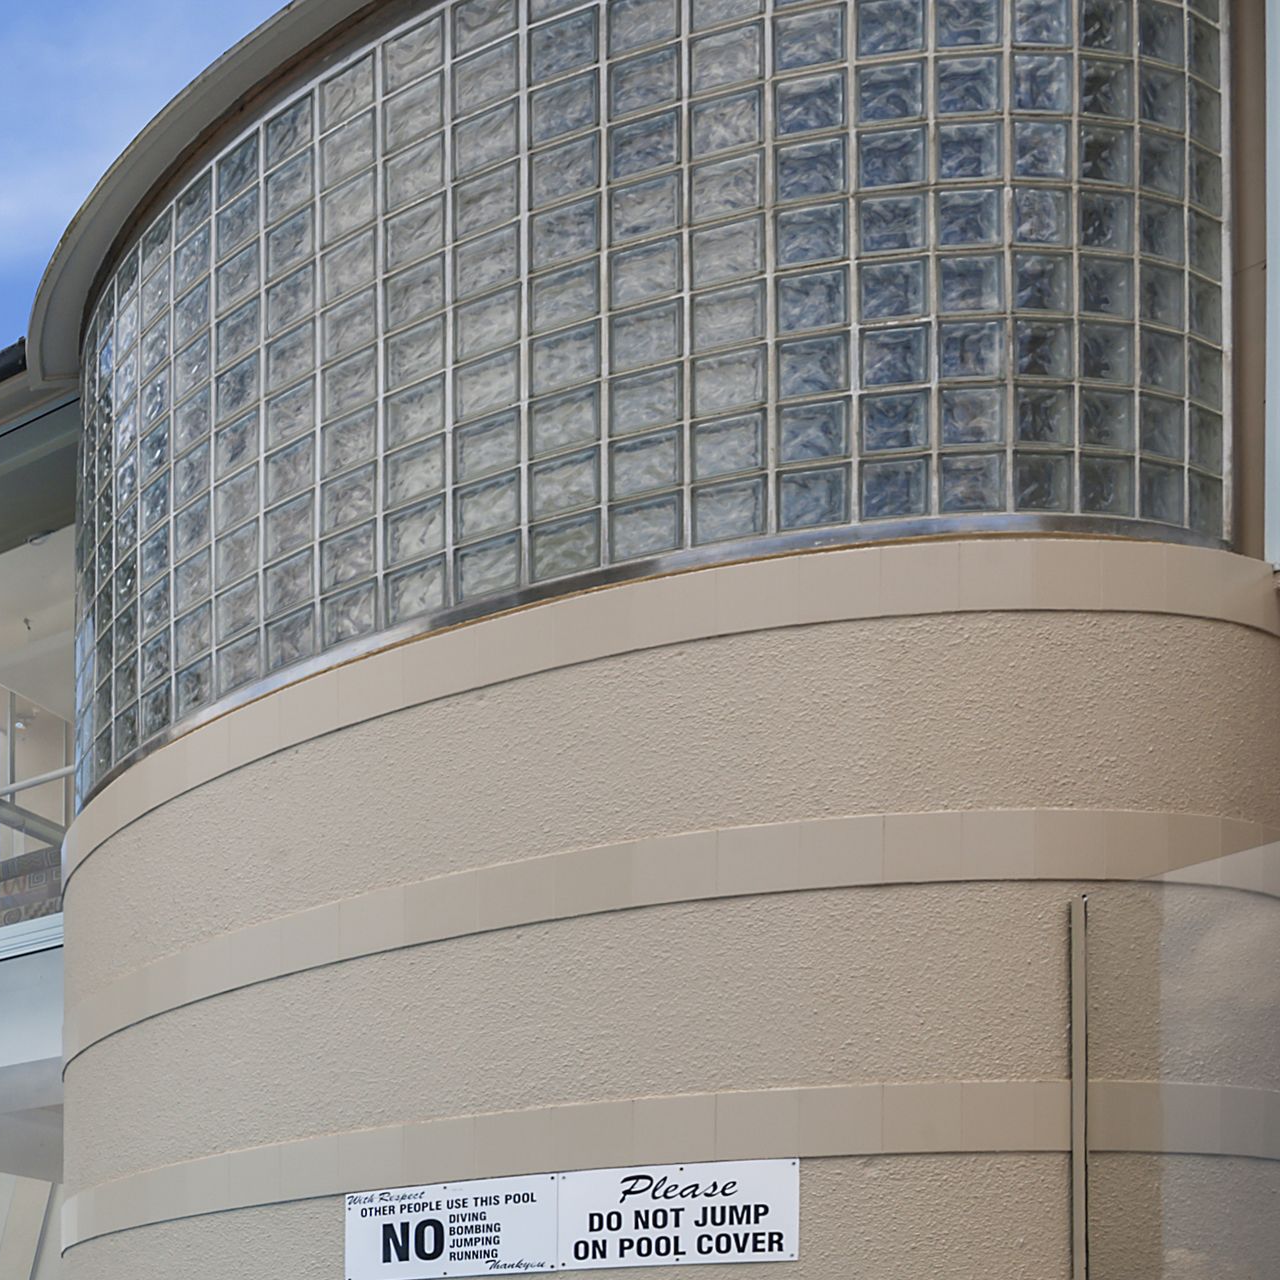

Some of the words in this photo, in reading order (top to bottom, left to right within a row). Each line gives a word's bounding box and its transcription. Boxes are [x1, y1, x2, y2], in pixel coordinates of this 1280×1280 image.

[347, 1194, 374, 1206] With
[378, 1191, 425, 1203] Respect
[619, 1175, 738, 1203] Please
[360, 1205, 395, 1218] OTHER
[400, 1200, 442, 1214] PEOPLE
[447, 1198, 469, 1210] USE
[473, 1195, 500, 1207] THIS
[505, 1192, 537, 1204] POOL
[449, 1211, 487, 1224] DIVING
[589, 1211, 622, 1232] DO
[634, 1208, 685, 1230] NOT
[694, 1204, 769, 1228] JUMP
[449, 1223, 501, 1236] BOMBING
[382, 1218, 445, 1263] NO
[449, 1235, 500, 1248] JUMPING
[574, 1239, 607, 1260] ON
[619, 1235, 686, 1258] POOL
[697, 1231, 784, 1254] COVER
[449, 1249, 498, 1261] RUNNING
